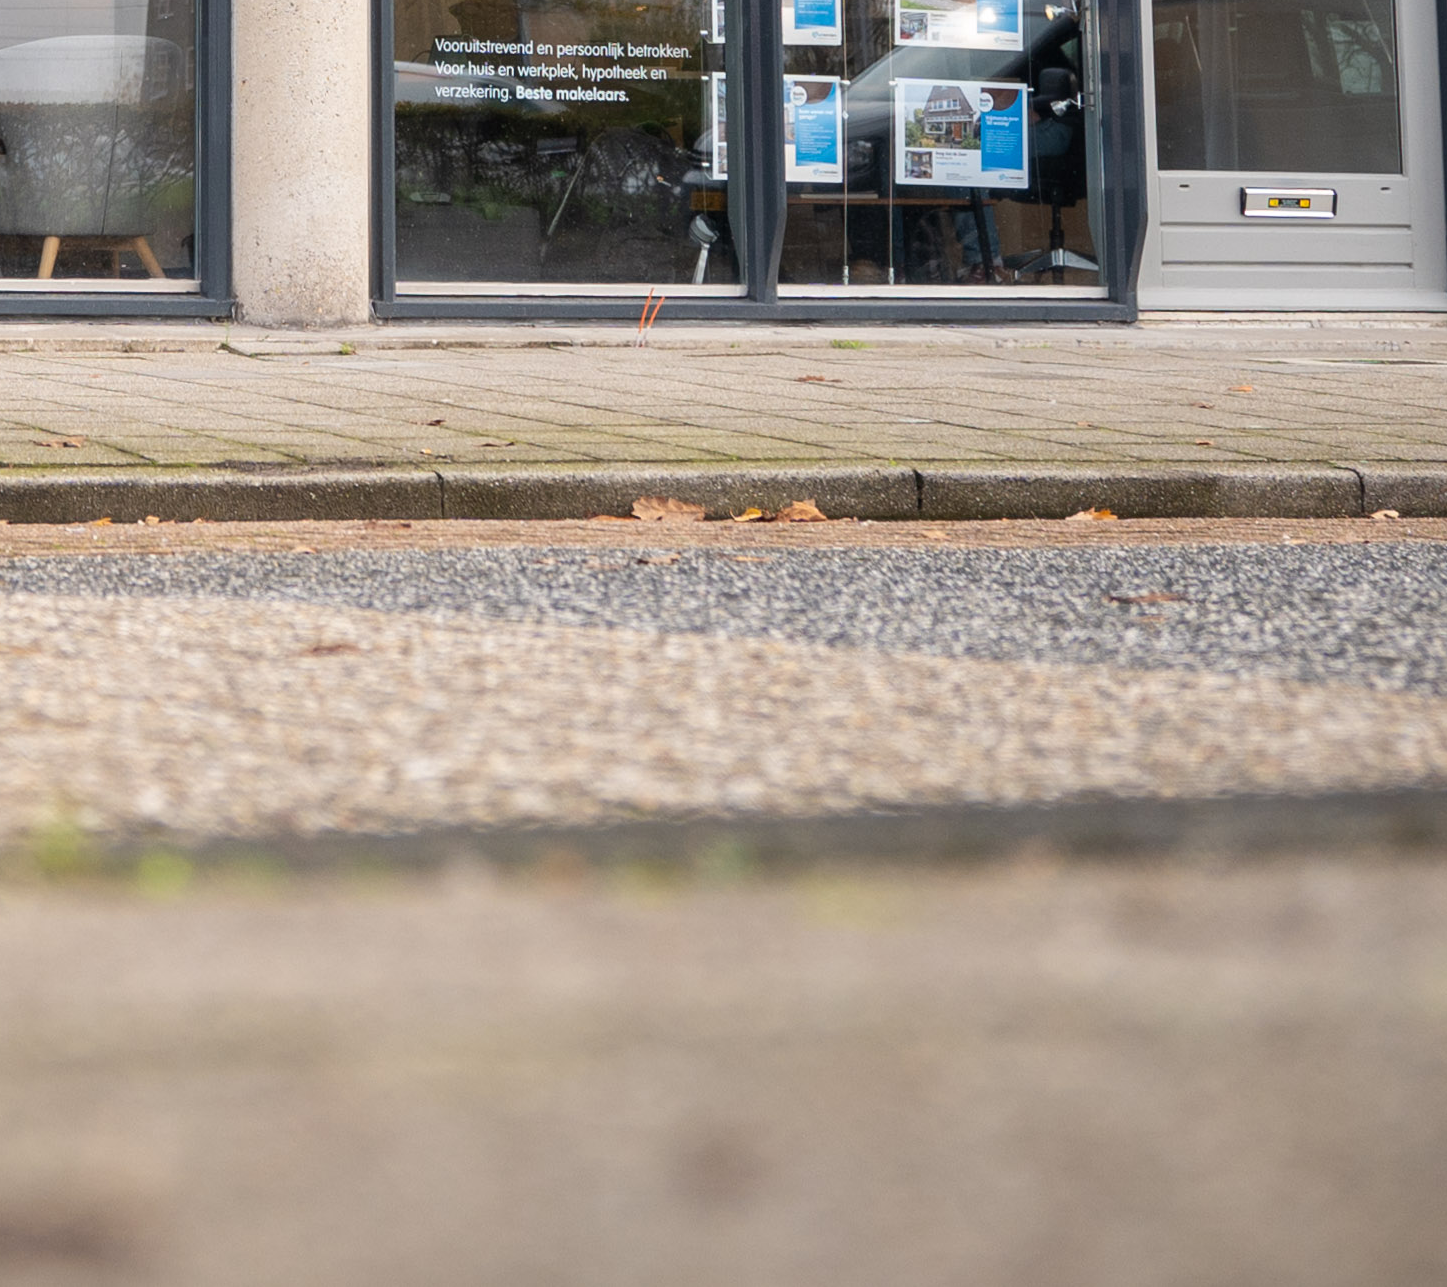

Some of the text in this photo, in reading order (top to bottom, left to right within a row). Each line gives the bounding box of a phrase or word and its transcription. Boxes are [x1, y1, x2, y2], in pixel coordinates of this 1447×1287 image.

[435, 38, 692, 60] Vooruitstrevend en persoonlijk betrokken.
[435, 61, 667, 84] Voor huis en werkplek, hypotheek en
[435, 85, 630, 102] verzekering. Beste makelaars.
